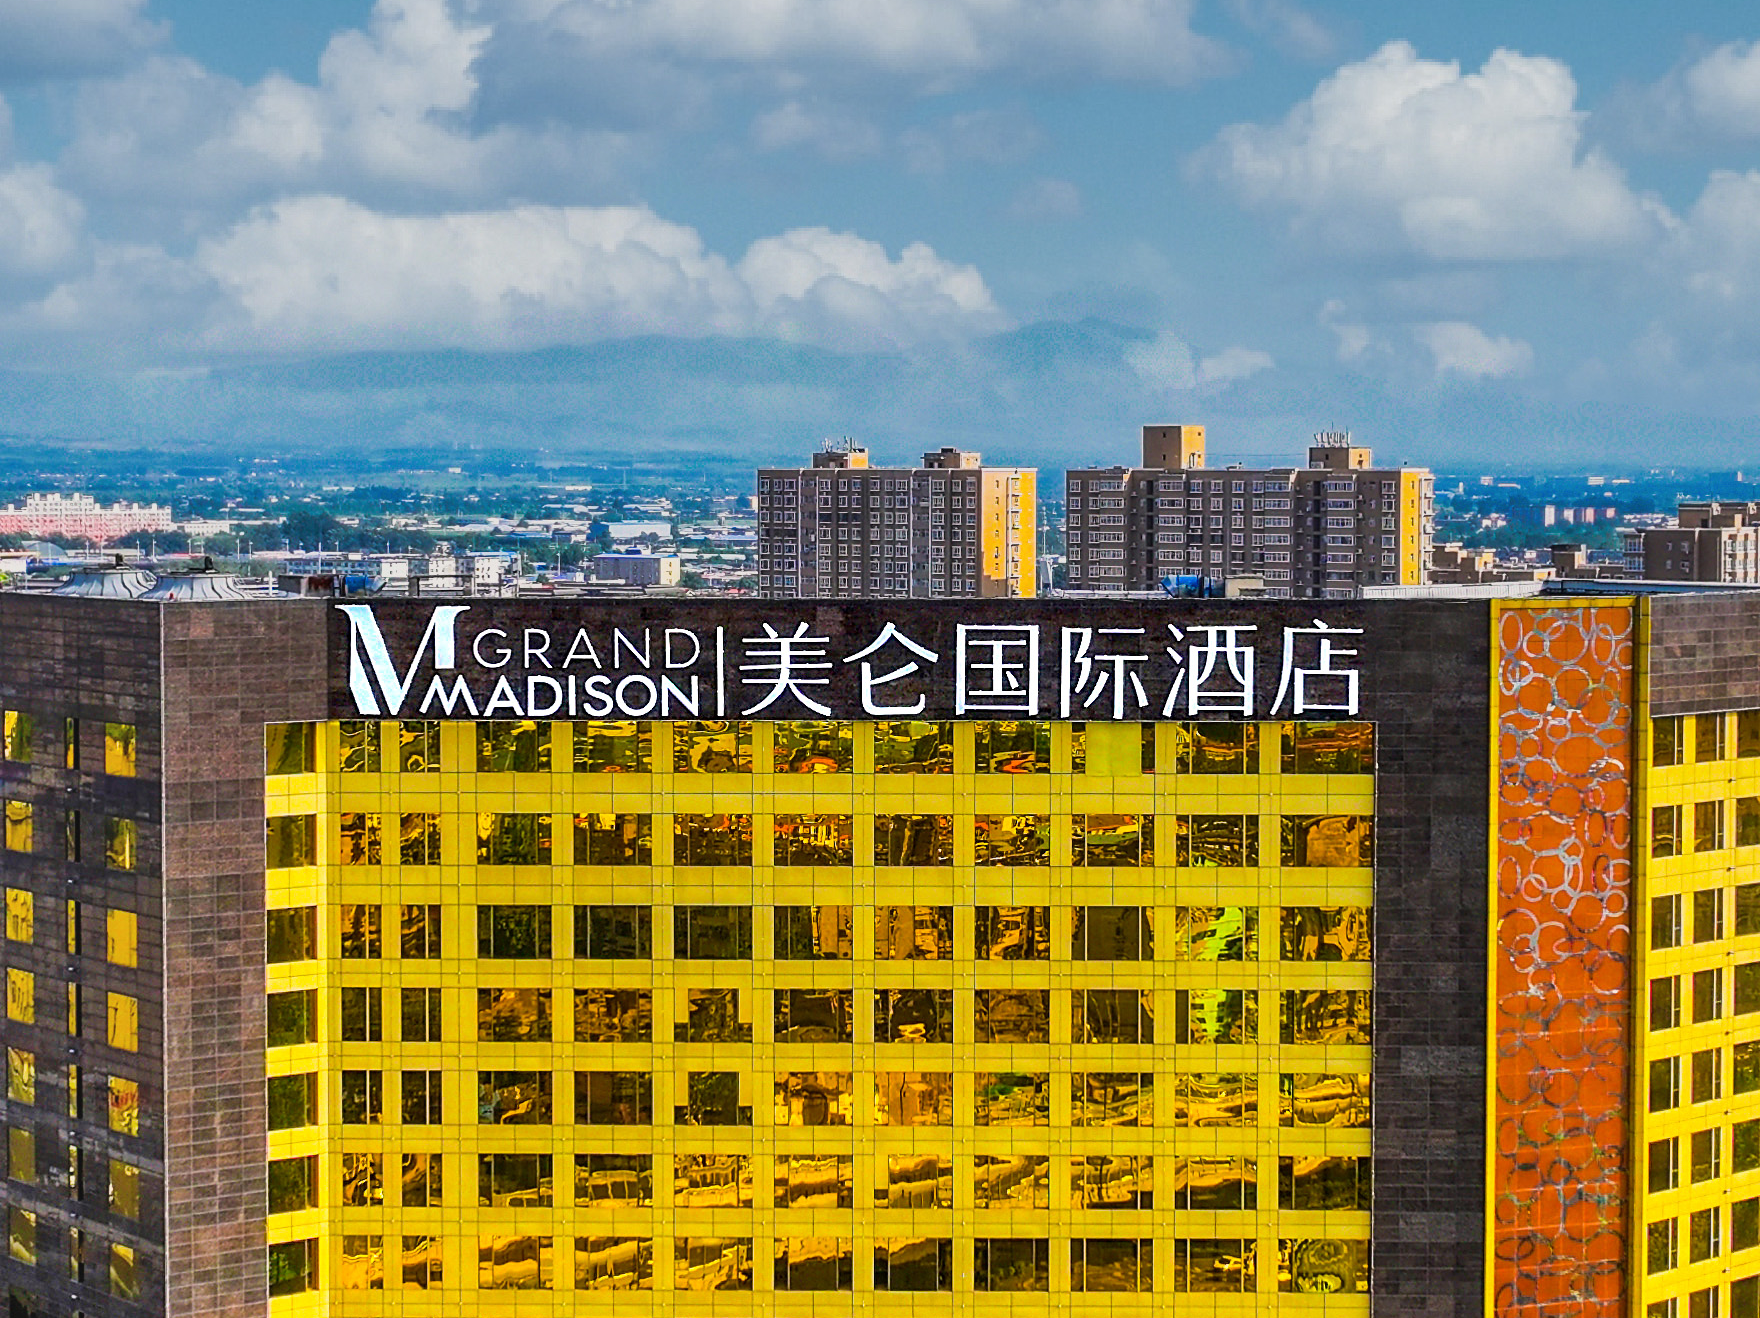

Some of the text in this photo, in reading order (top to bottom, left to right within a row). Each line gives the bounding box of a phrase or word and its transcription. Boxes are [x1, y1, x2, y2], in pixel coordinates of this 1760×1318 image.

[473, 628, 700, 668] GRAND
[740, 619, 1364, 718] 美仑国际酒店
[419, 675, 699, 716] MADISON
